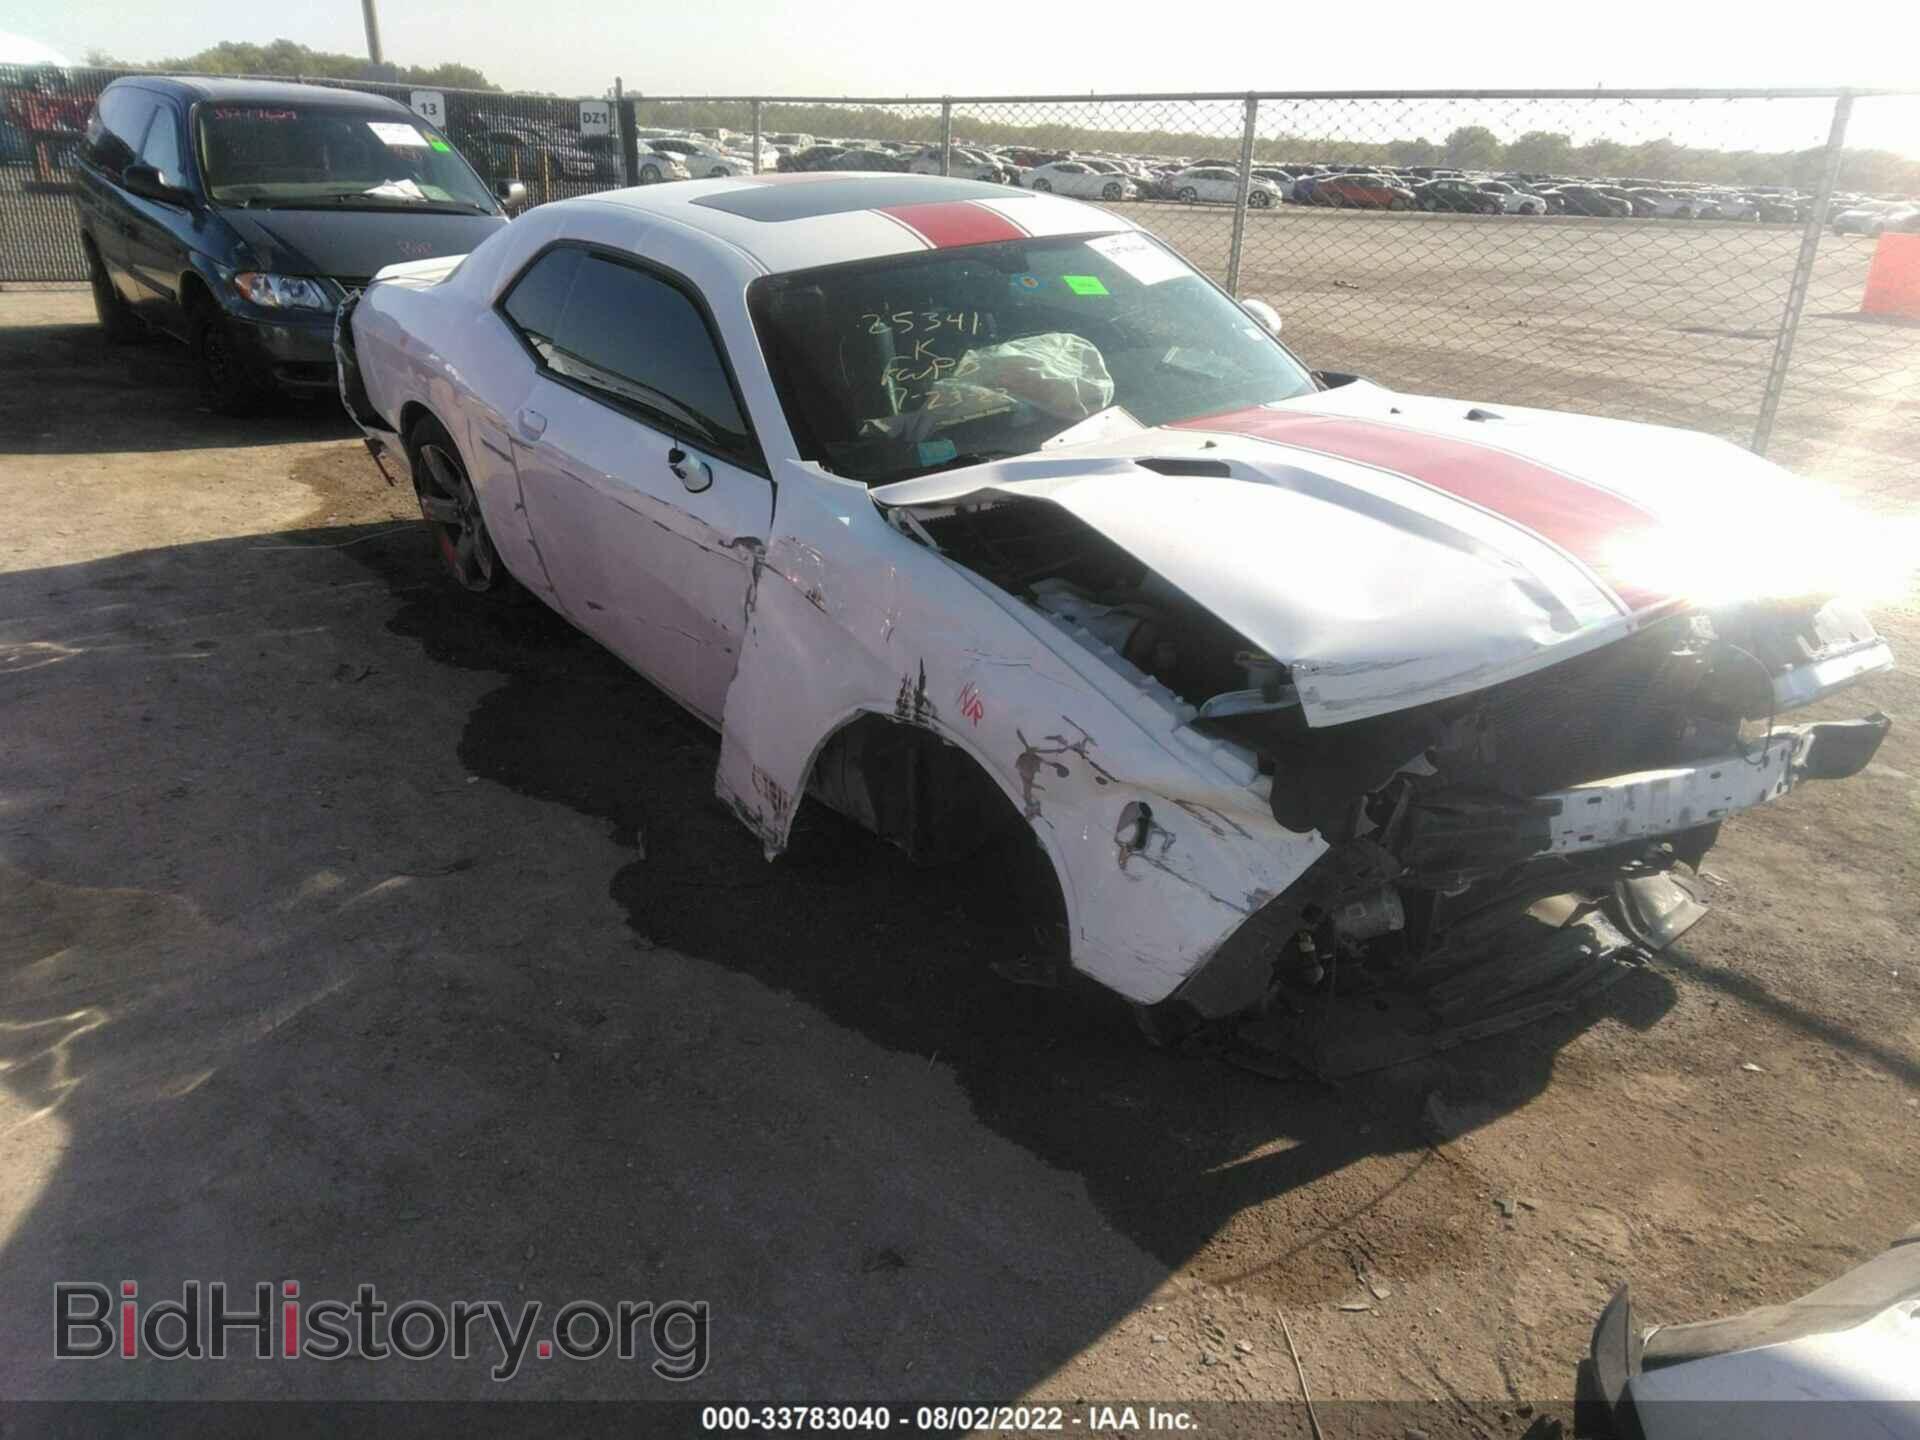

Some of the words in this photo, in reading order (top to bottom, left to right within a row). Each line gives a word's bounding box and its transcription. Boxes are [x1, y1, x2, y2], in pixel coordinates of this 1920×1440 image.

[420, 102, 437, 116] 13
[582, 110, 608, 125] DZ1
[861, 311, 980, 335] 25341
[914, 337, 939, 361] K
